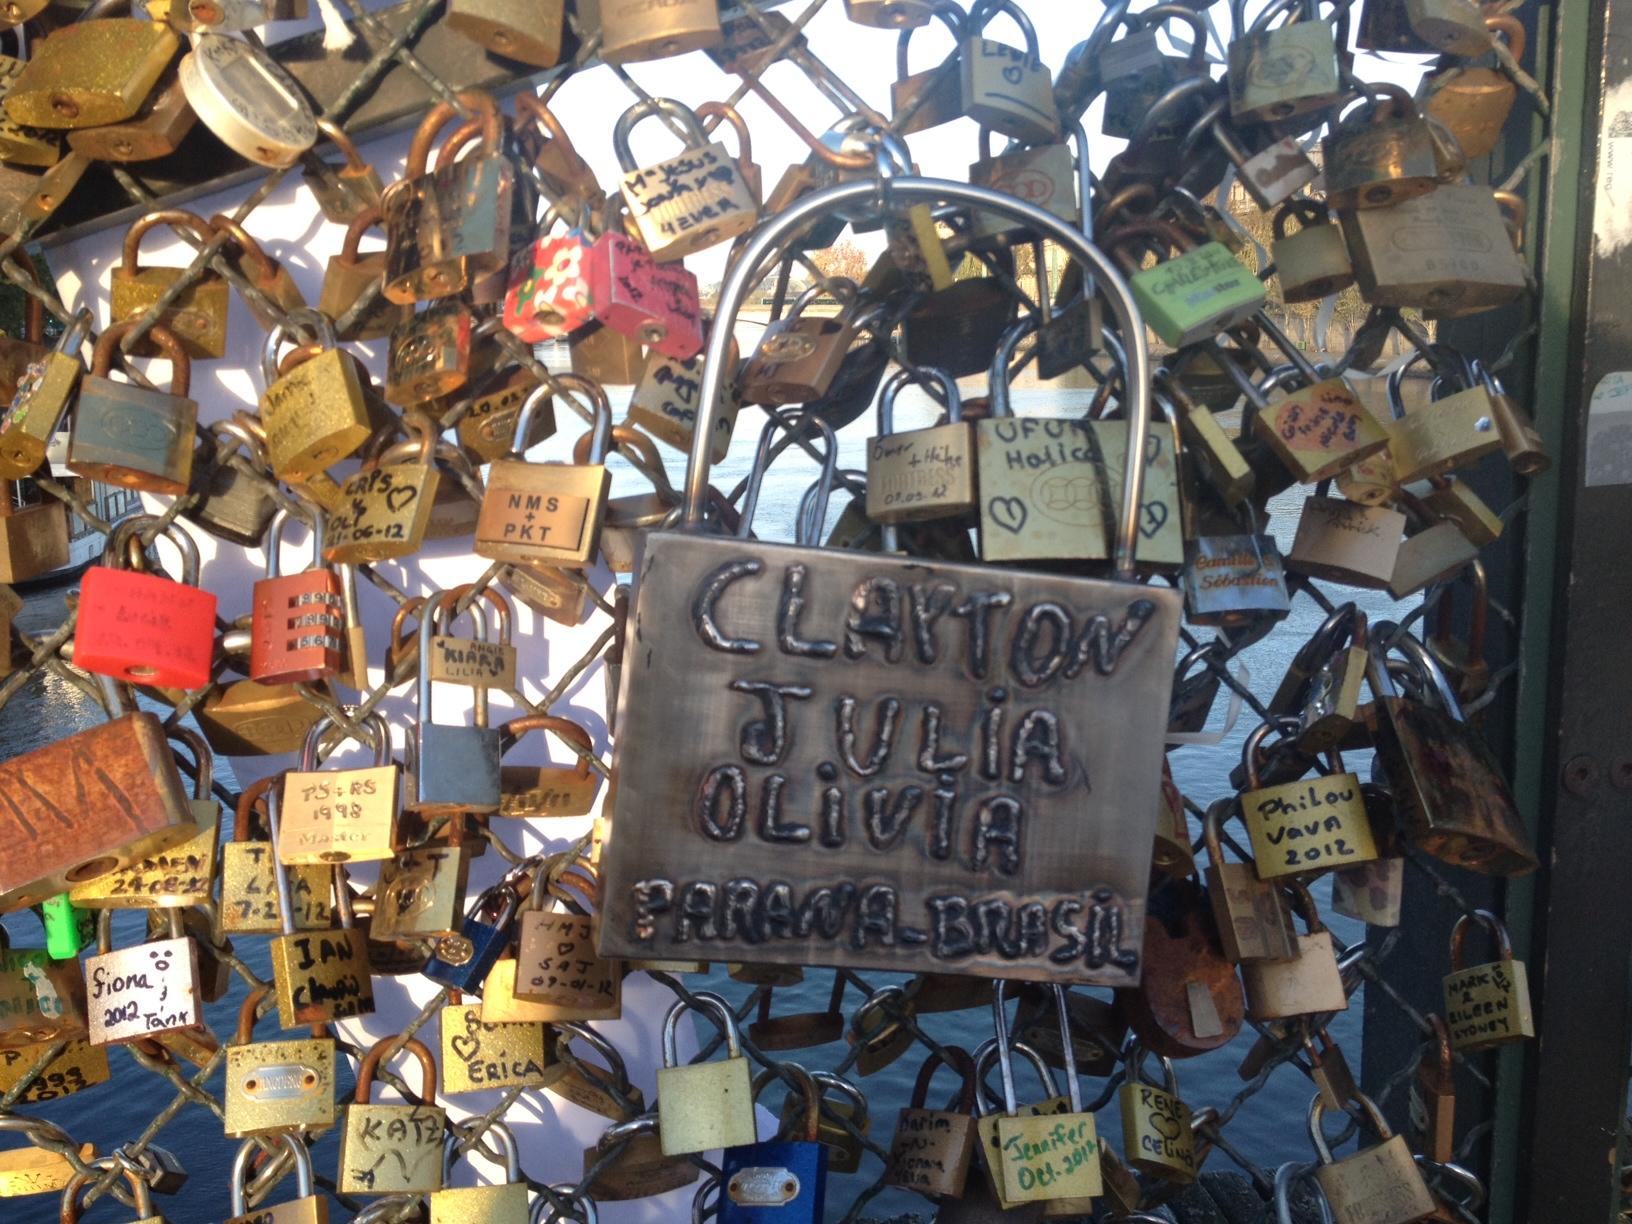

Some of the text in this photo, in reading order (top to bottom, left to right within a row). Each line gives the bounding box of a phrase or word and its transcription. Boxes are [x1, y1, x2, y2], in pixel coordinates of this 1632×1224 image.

[508, 494, 560, 513] NMS
[503, 523, 552, 542] PKT
[692, 557, 1155, 688] CLAYTON
[313, 802, 362, 820] 1998
[1285, 839, 1355, 865] 2012
[104, 1001, 140, 1027] 2012
[1003, 1120, 1087, 1162] Jennifer
